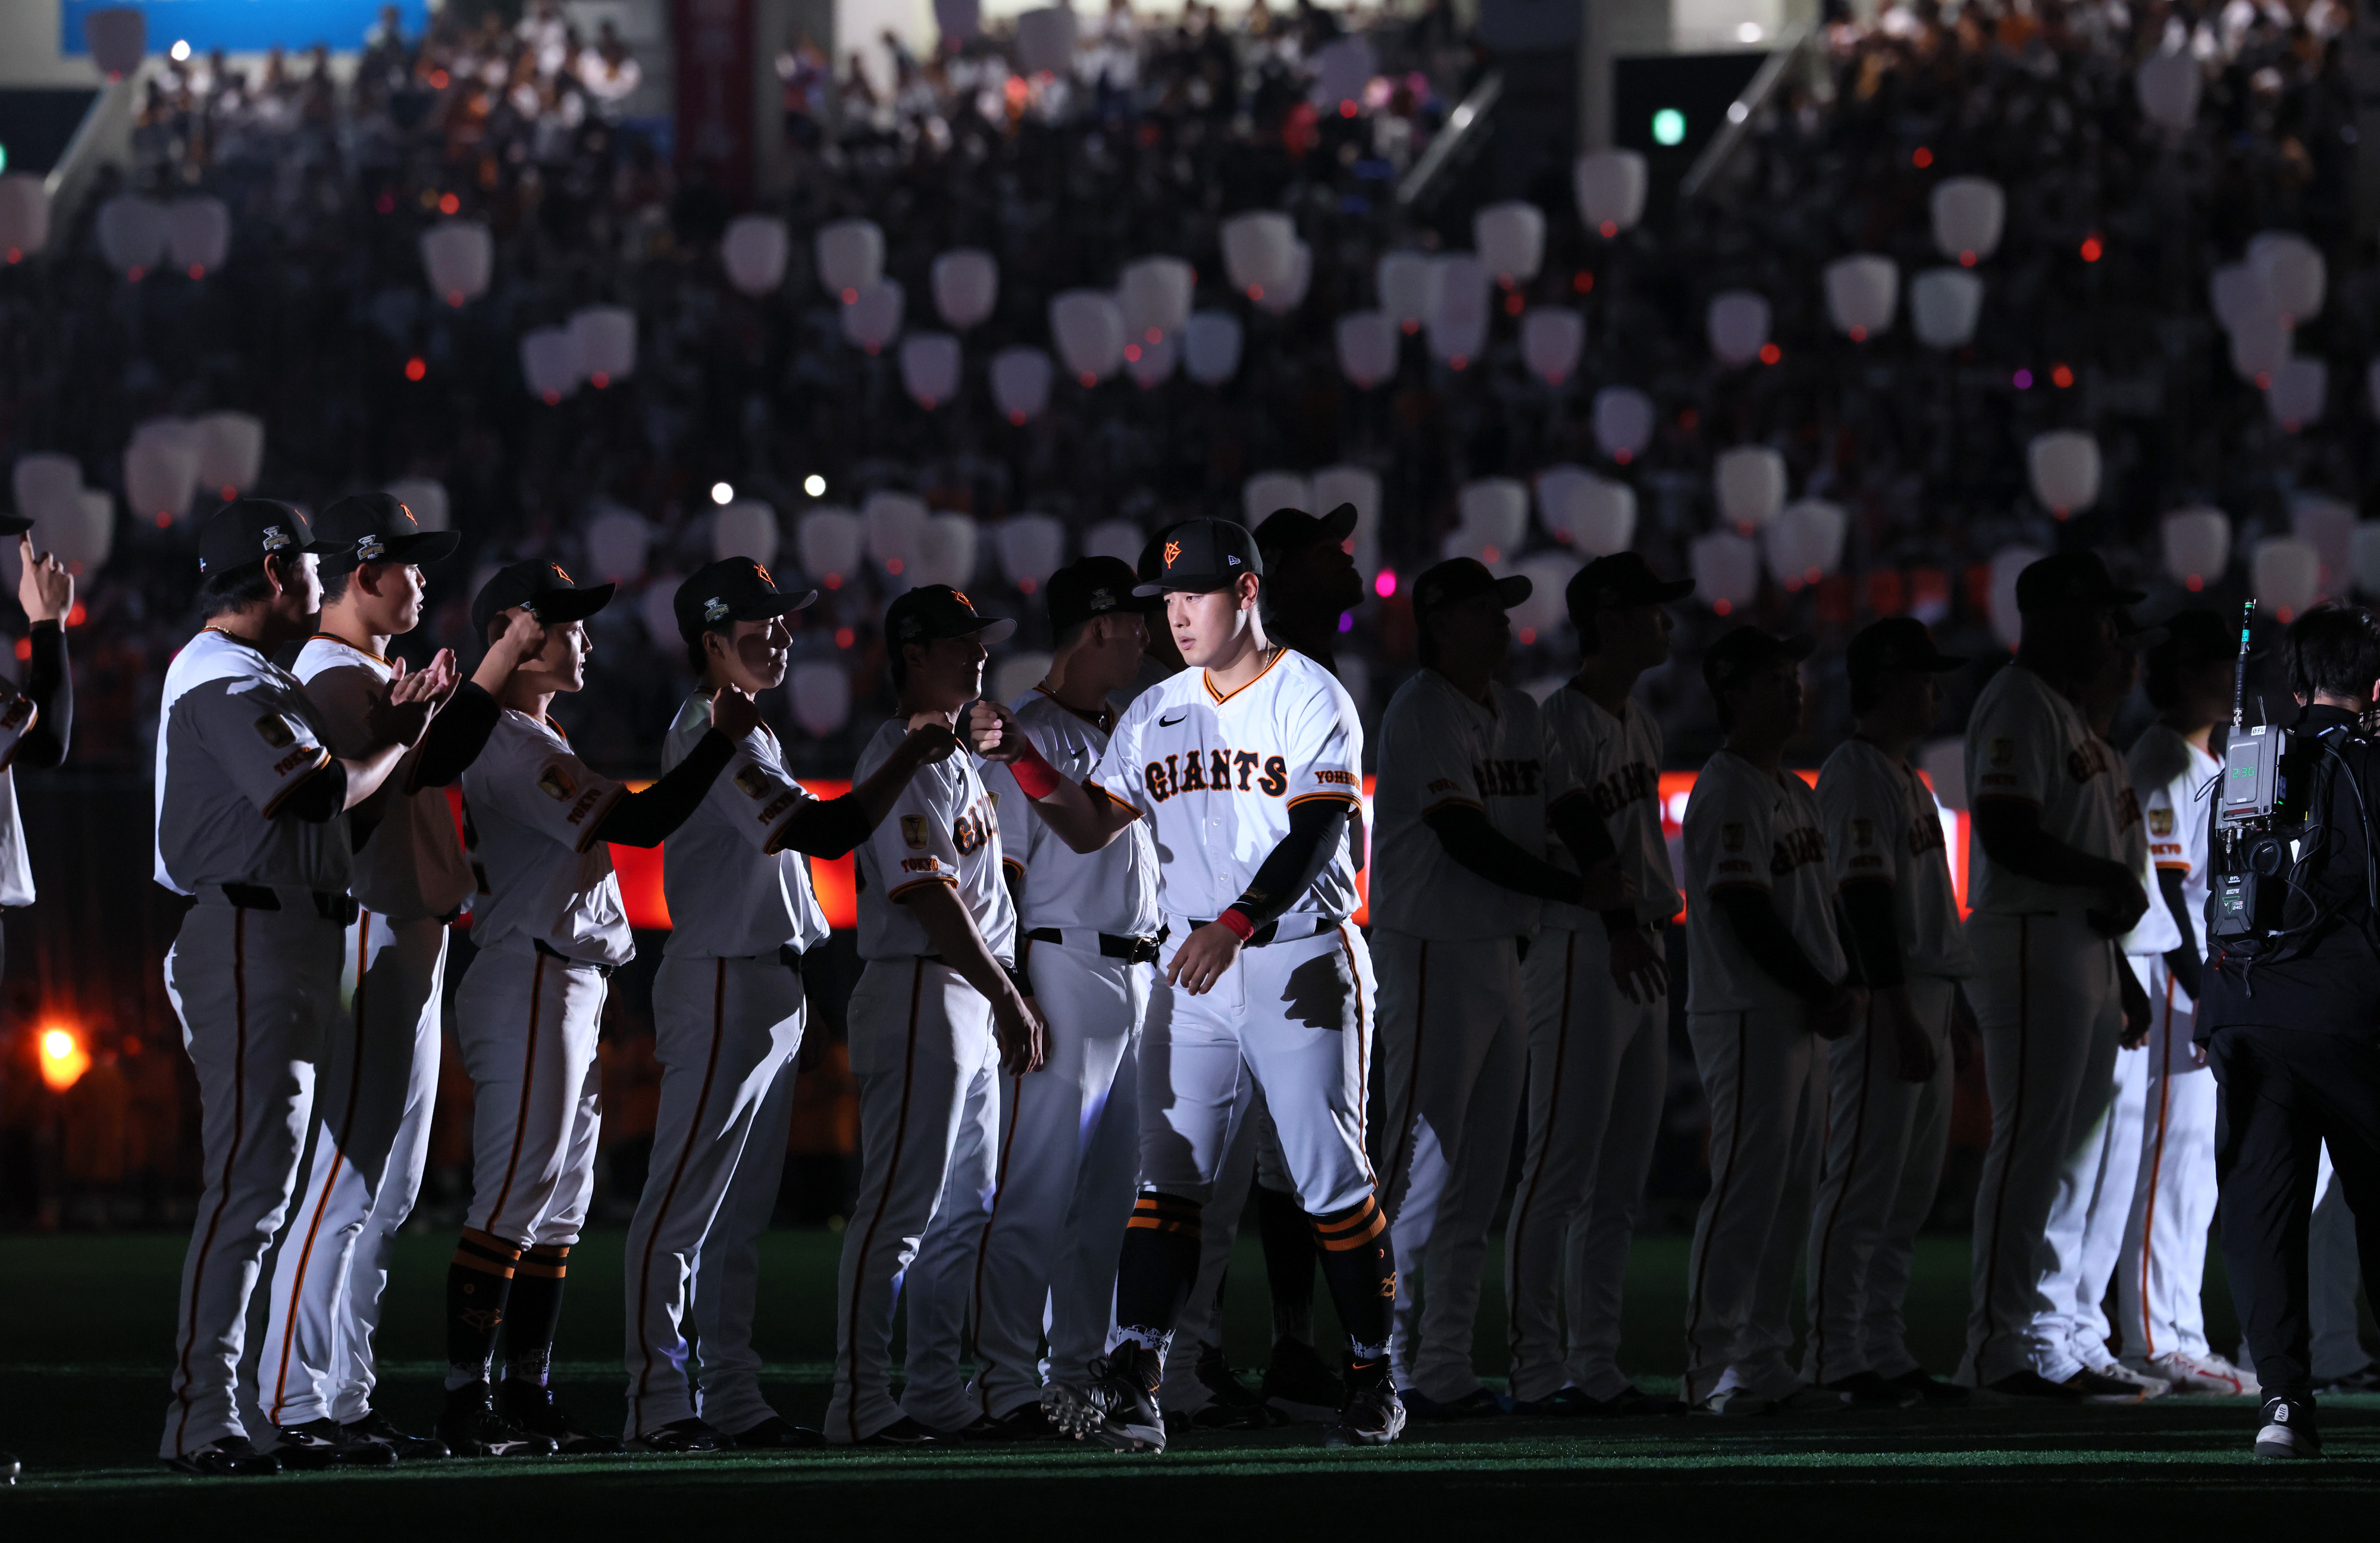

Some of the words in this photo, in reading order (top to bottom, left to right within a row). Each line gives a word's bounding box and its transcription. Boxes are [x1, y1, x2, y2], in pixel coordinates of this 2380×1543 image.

[1145, 749, 1288, 803] GIANTS
[566, 788, 602, 826] TOKYO
[757, 792, 796, 826] TOKYO
[901, 858, 940, 873] TOKYO
